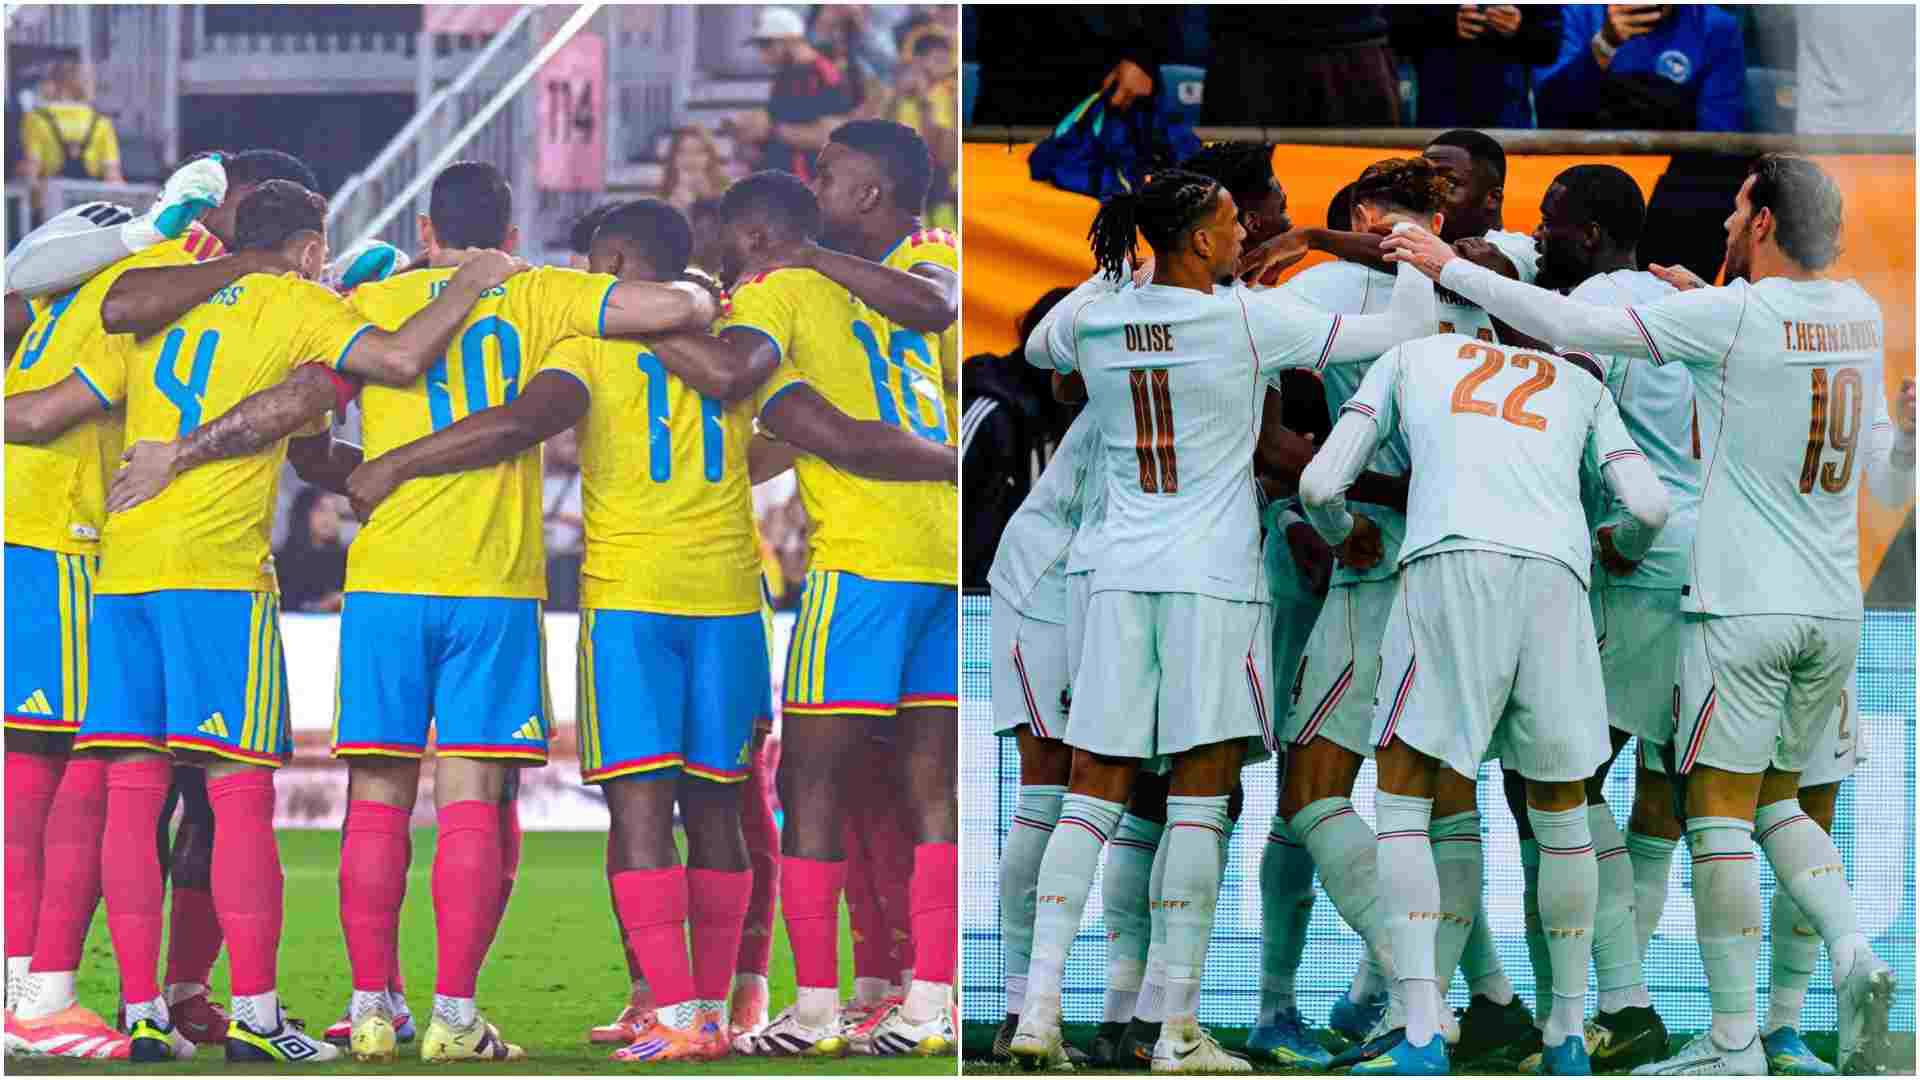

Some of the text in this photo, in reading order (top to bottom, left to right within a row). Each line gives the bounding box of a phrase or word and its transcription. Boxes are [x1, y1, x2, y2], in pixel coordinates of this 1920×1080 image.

[154, 327, 219, 440] 4
[427, 314, 521, 432] 10
[1124, 323, 1174, 353] OLISE
[1450, 342, 1557, 433] 22
[637, 352, 725, 483] 11
[1128, 368, 1178, 495] 11
[1799, 367, 1864, 495] 19
